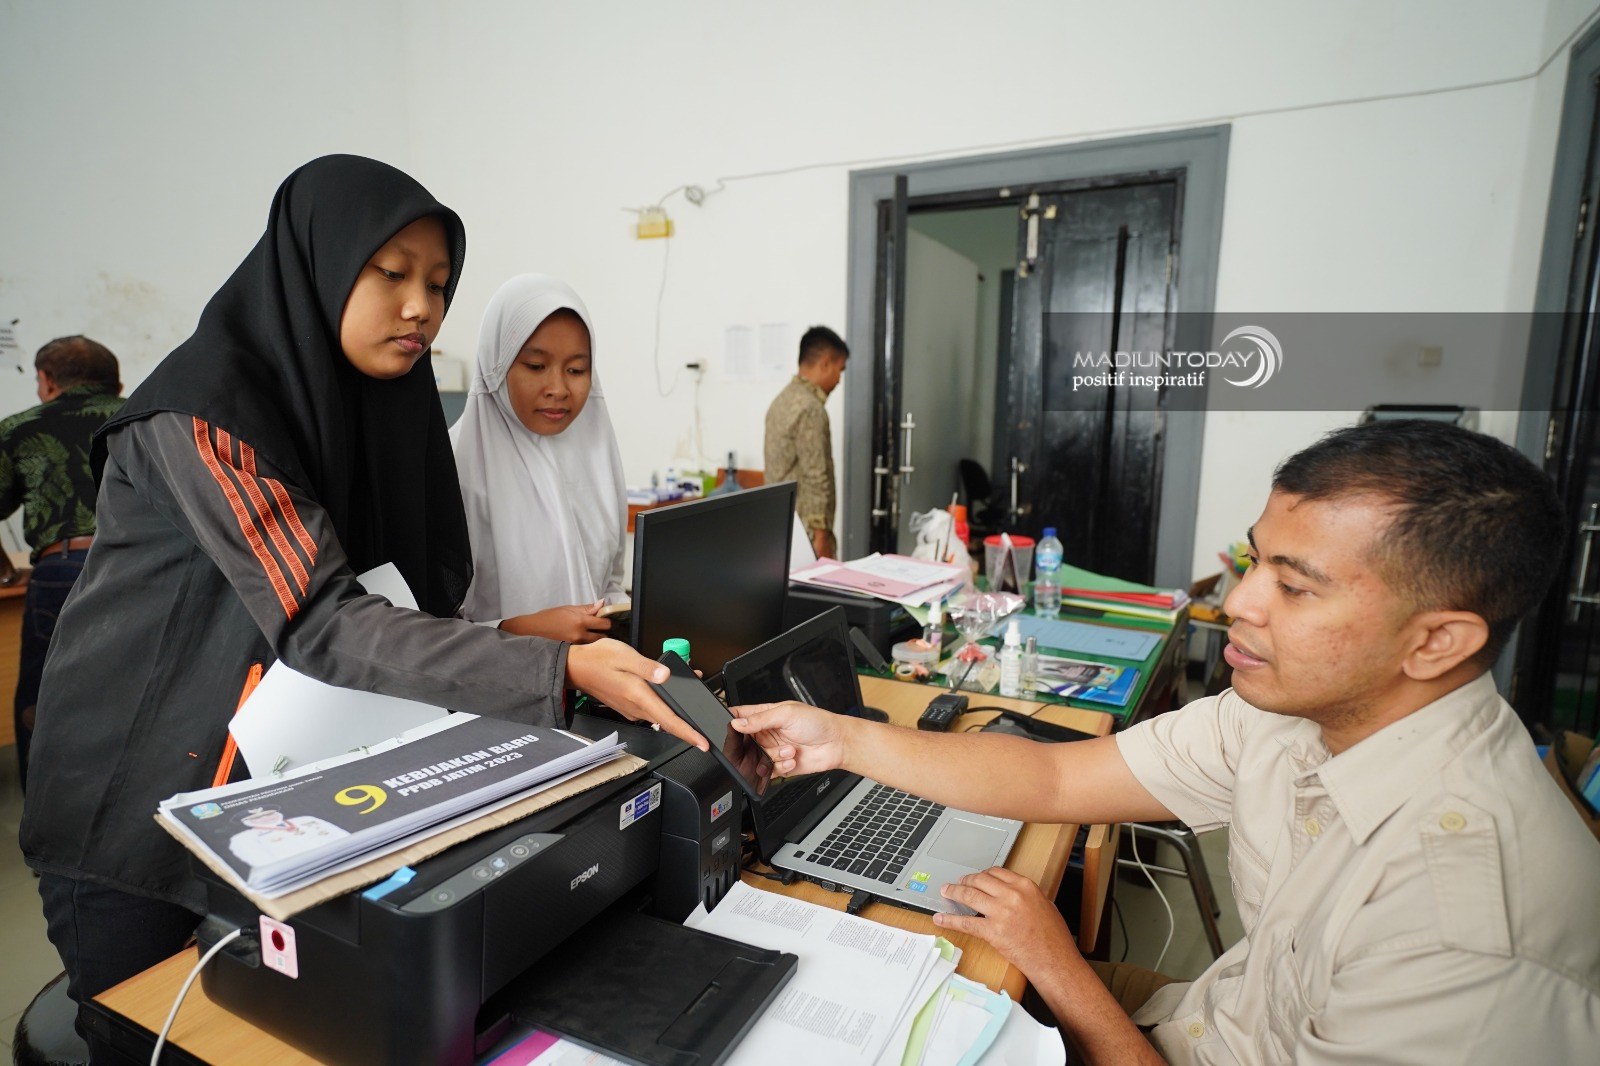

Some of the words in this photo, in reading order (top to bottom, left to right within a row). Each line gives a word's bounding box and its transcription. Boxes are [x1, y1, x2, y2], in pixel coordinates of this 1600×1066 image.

[382, 749, 492, 790] KEBIJAKAN
[487, 734, 540, 756] BARU
[397, 774, 444, 798] PPDB
[446, 763, 488, 784] JATIM
[484, 751, 524, 768] 2023
[334, 784, 388, 815] 9
[570, 862, 599, 890] EPSON
